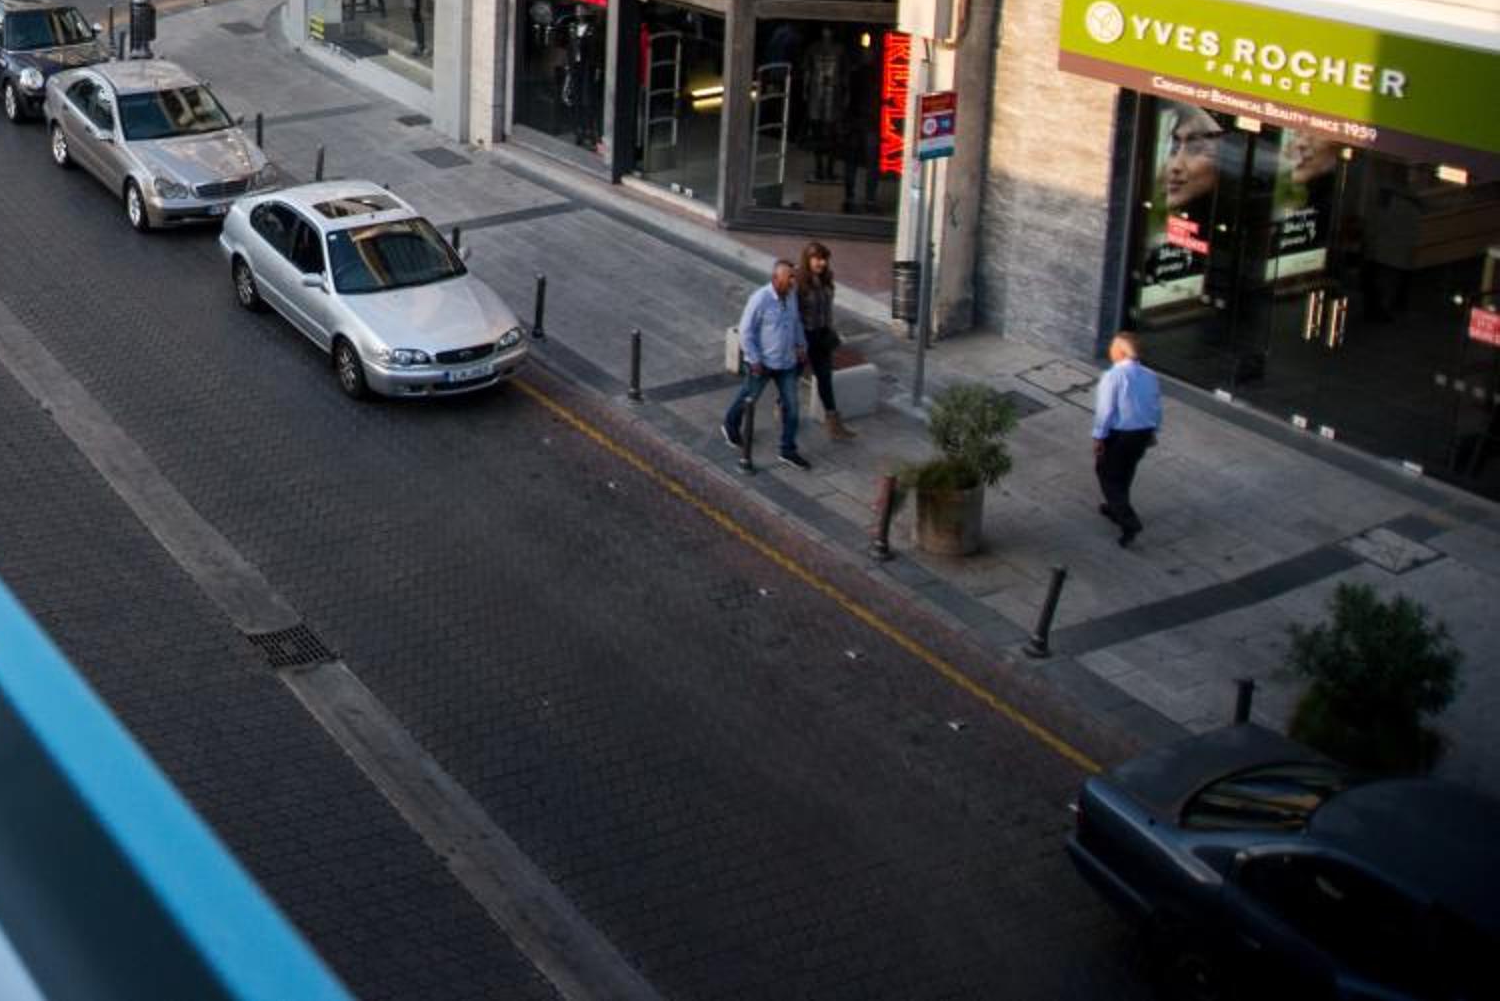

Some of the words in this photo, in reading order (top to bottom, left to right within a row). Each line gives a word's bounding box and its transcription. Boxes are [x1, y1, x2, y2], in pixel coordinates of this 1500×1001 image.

[1130, 14, 1220, 57] YVES
[1232, 37, 1406, 98] ROCHER
[1205, 59, 1312, 96] FRANCE
